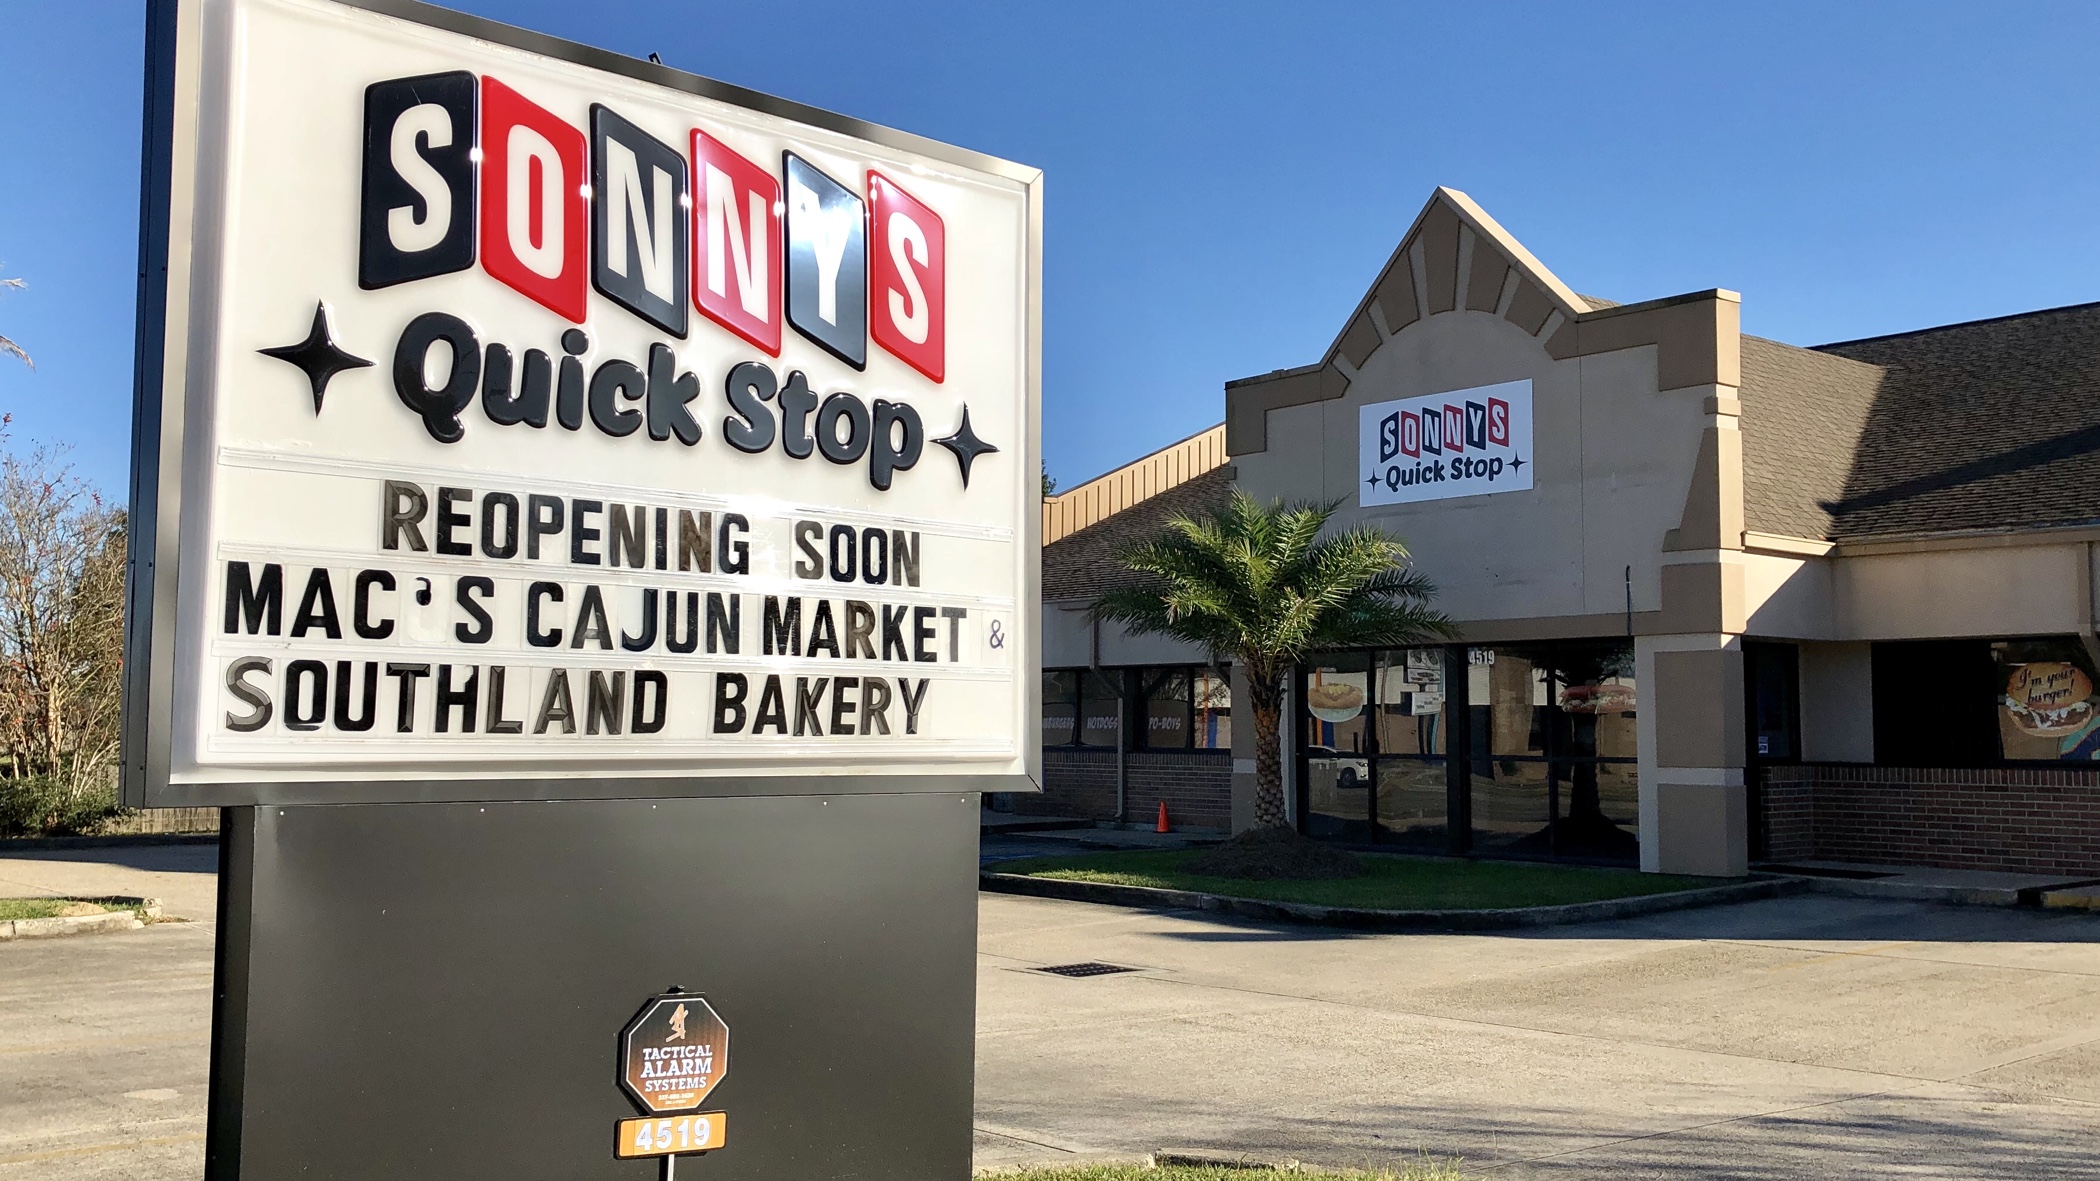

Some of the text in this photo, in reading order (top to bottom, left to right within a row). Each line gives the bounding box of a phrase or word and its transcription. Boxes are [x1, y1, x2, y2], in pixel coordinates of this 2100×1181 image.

[387, 102, 930, 346] SONNYS
[393, 311, 924, 491] Quick Stop
[1382, 402, 1506, 456] SONNYS
[1385, 456, 1504, 493] Quick Stop
[382, 479, 921, 588] REOPENING SOON
[224, 560, 1005, 663] MAC'S CAJUN MARKET &
[1469, 650, 1495, 665] 4519
[225, 655, 931, 737] SOUTHLAND BAKERY
[2015, 668, 2077, 690] I'm your
[2028, 678, 2075, 705] burger!
[1149, 716, 1181, 730] PO-BOYS
[640, 1057, 713, 1079] ALARM
[642, 1044, 713, 1061] TACTICAL
[644, 1076, 707, 1093] SYSTEMS
[635, 1117, 711, 1152] 4519
